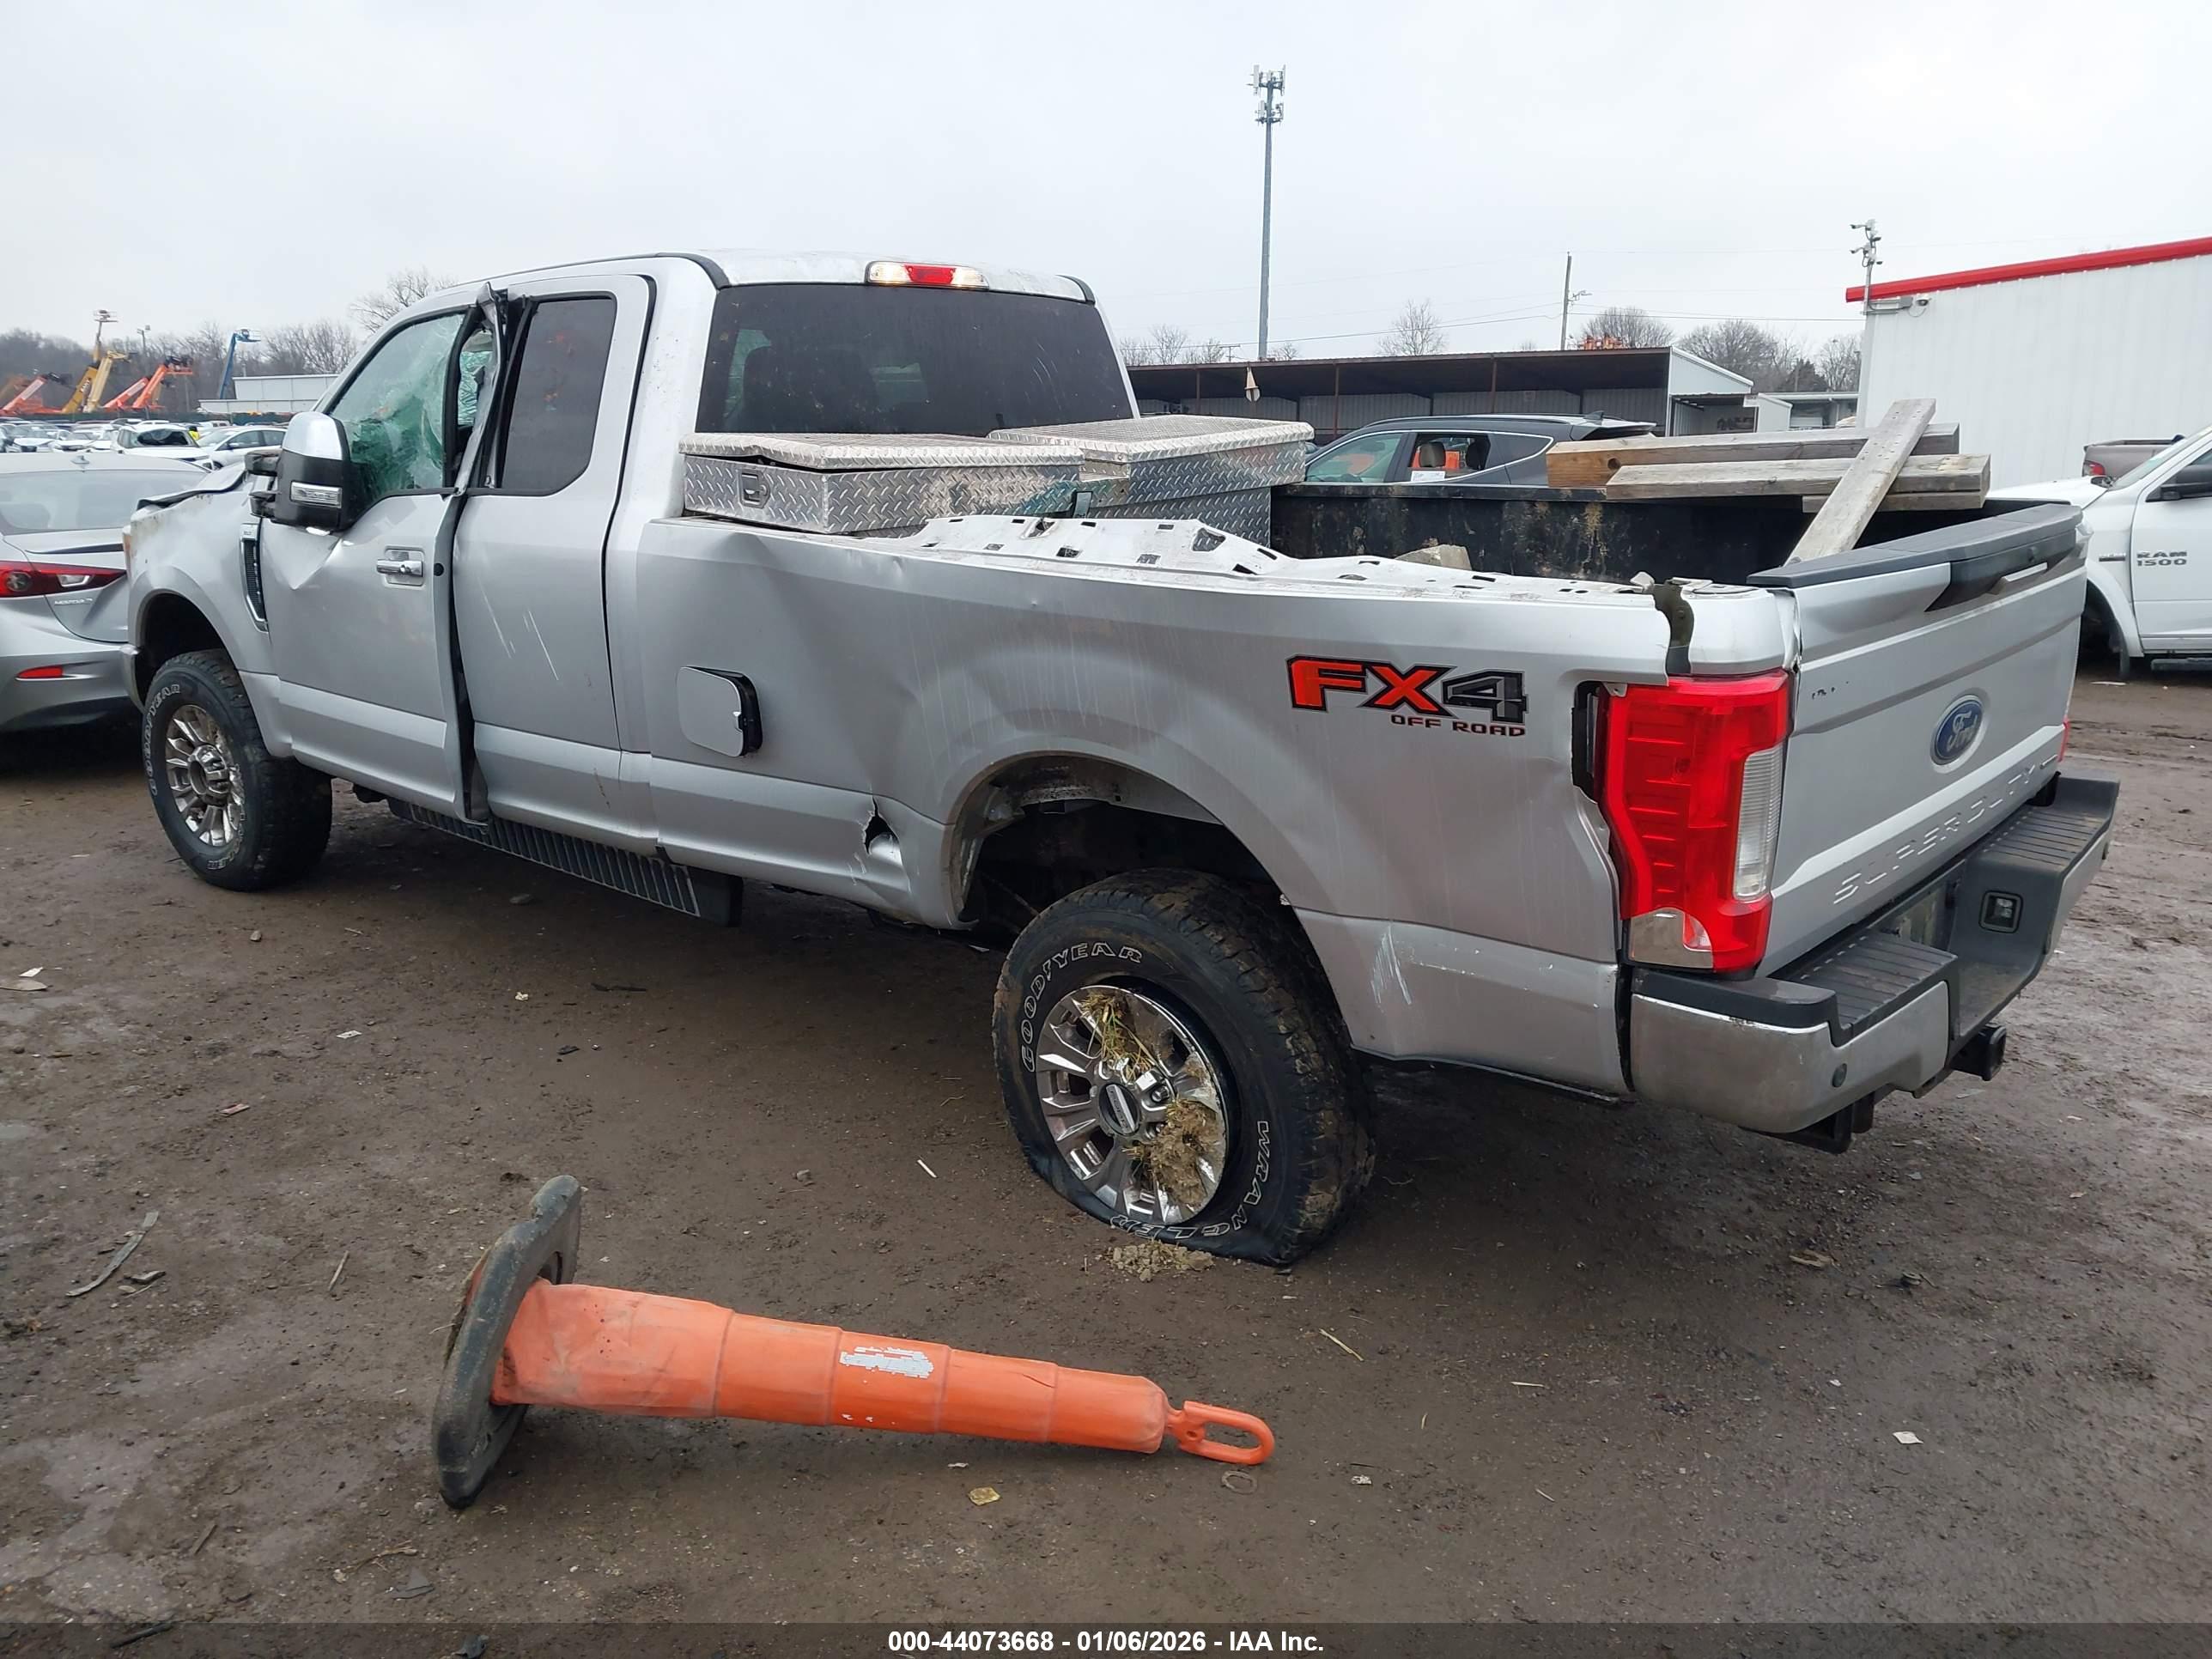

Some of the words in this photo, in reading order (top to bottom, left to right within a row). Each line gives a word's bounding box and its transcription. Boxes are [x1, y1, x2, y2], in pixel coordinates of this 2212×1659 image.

[2136, 558, 2187, 567] 1500
[1285, 653, 1528, 726] FX4
[1390, 713, 1443, 729] OFF
[1451, 720, 1527, 738] ROAD
[1020, 941, 1143, 1073] GOODYEAR
[1109, 1120, 1272, 1240] WRANGLER
